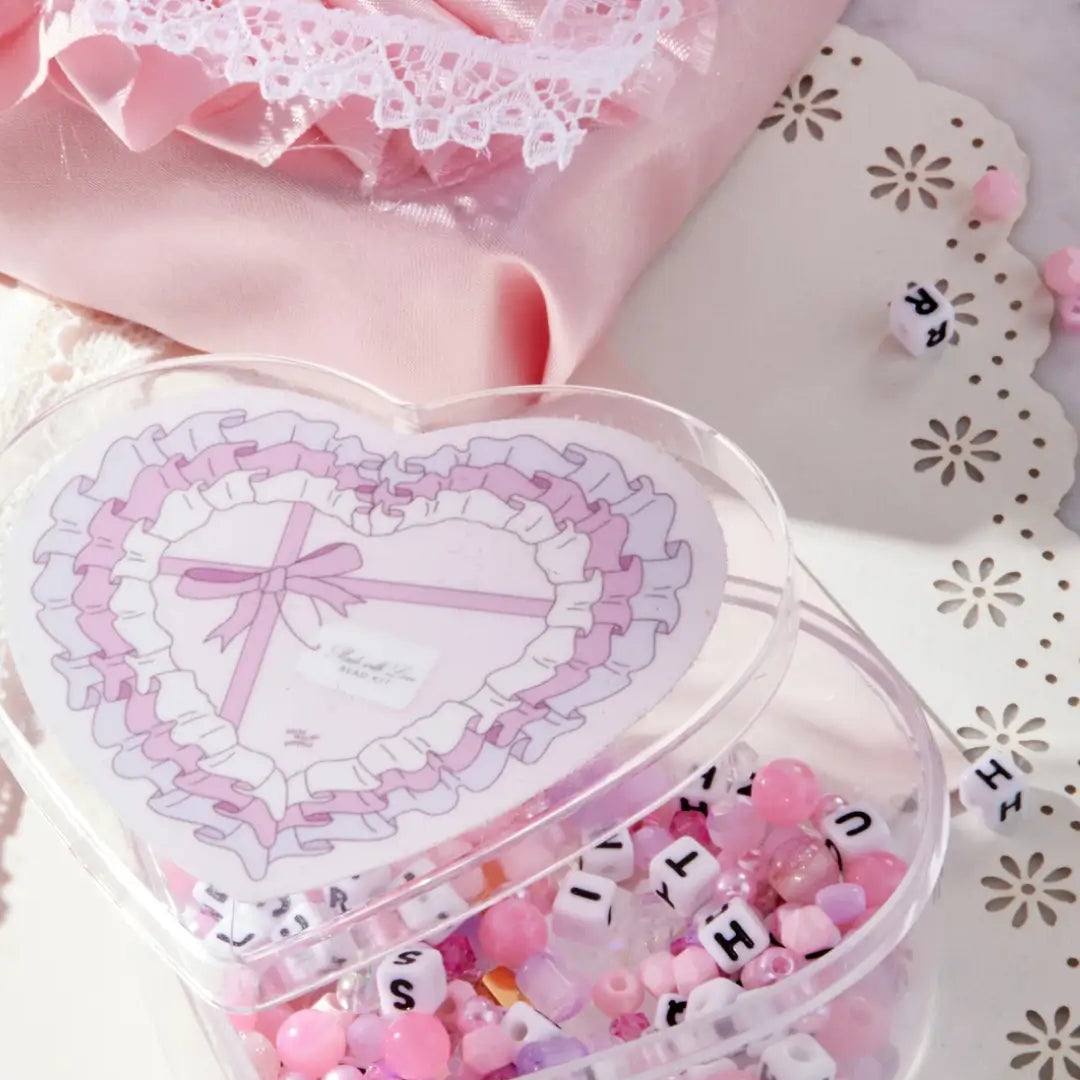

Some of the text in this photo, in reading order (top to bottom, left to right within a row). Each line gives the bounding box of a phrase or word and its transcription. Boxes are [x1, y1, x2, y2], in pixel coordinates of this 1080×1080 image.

[904, 288, 939, 315] R
[975, 758, 1013, 791] H
[835, 811, 872, 836] U
[664, 851, 699, 878] T
[713, 919, 755, 961] H
[389, 978, 416, 1012] S
